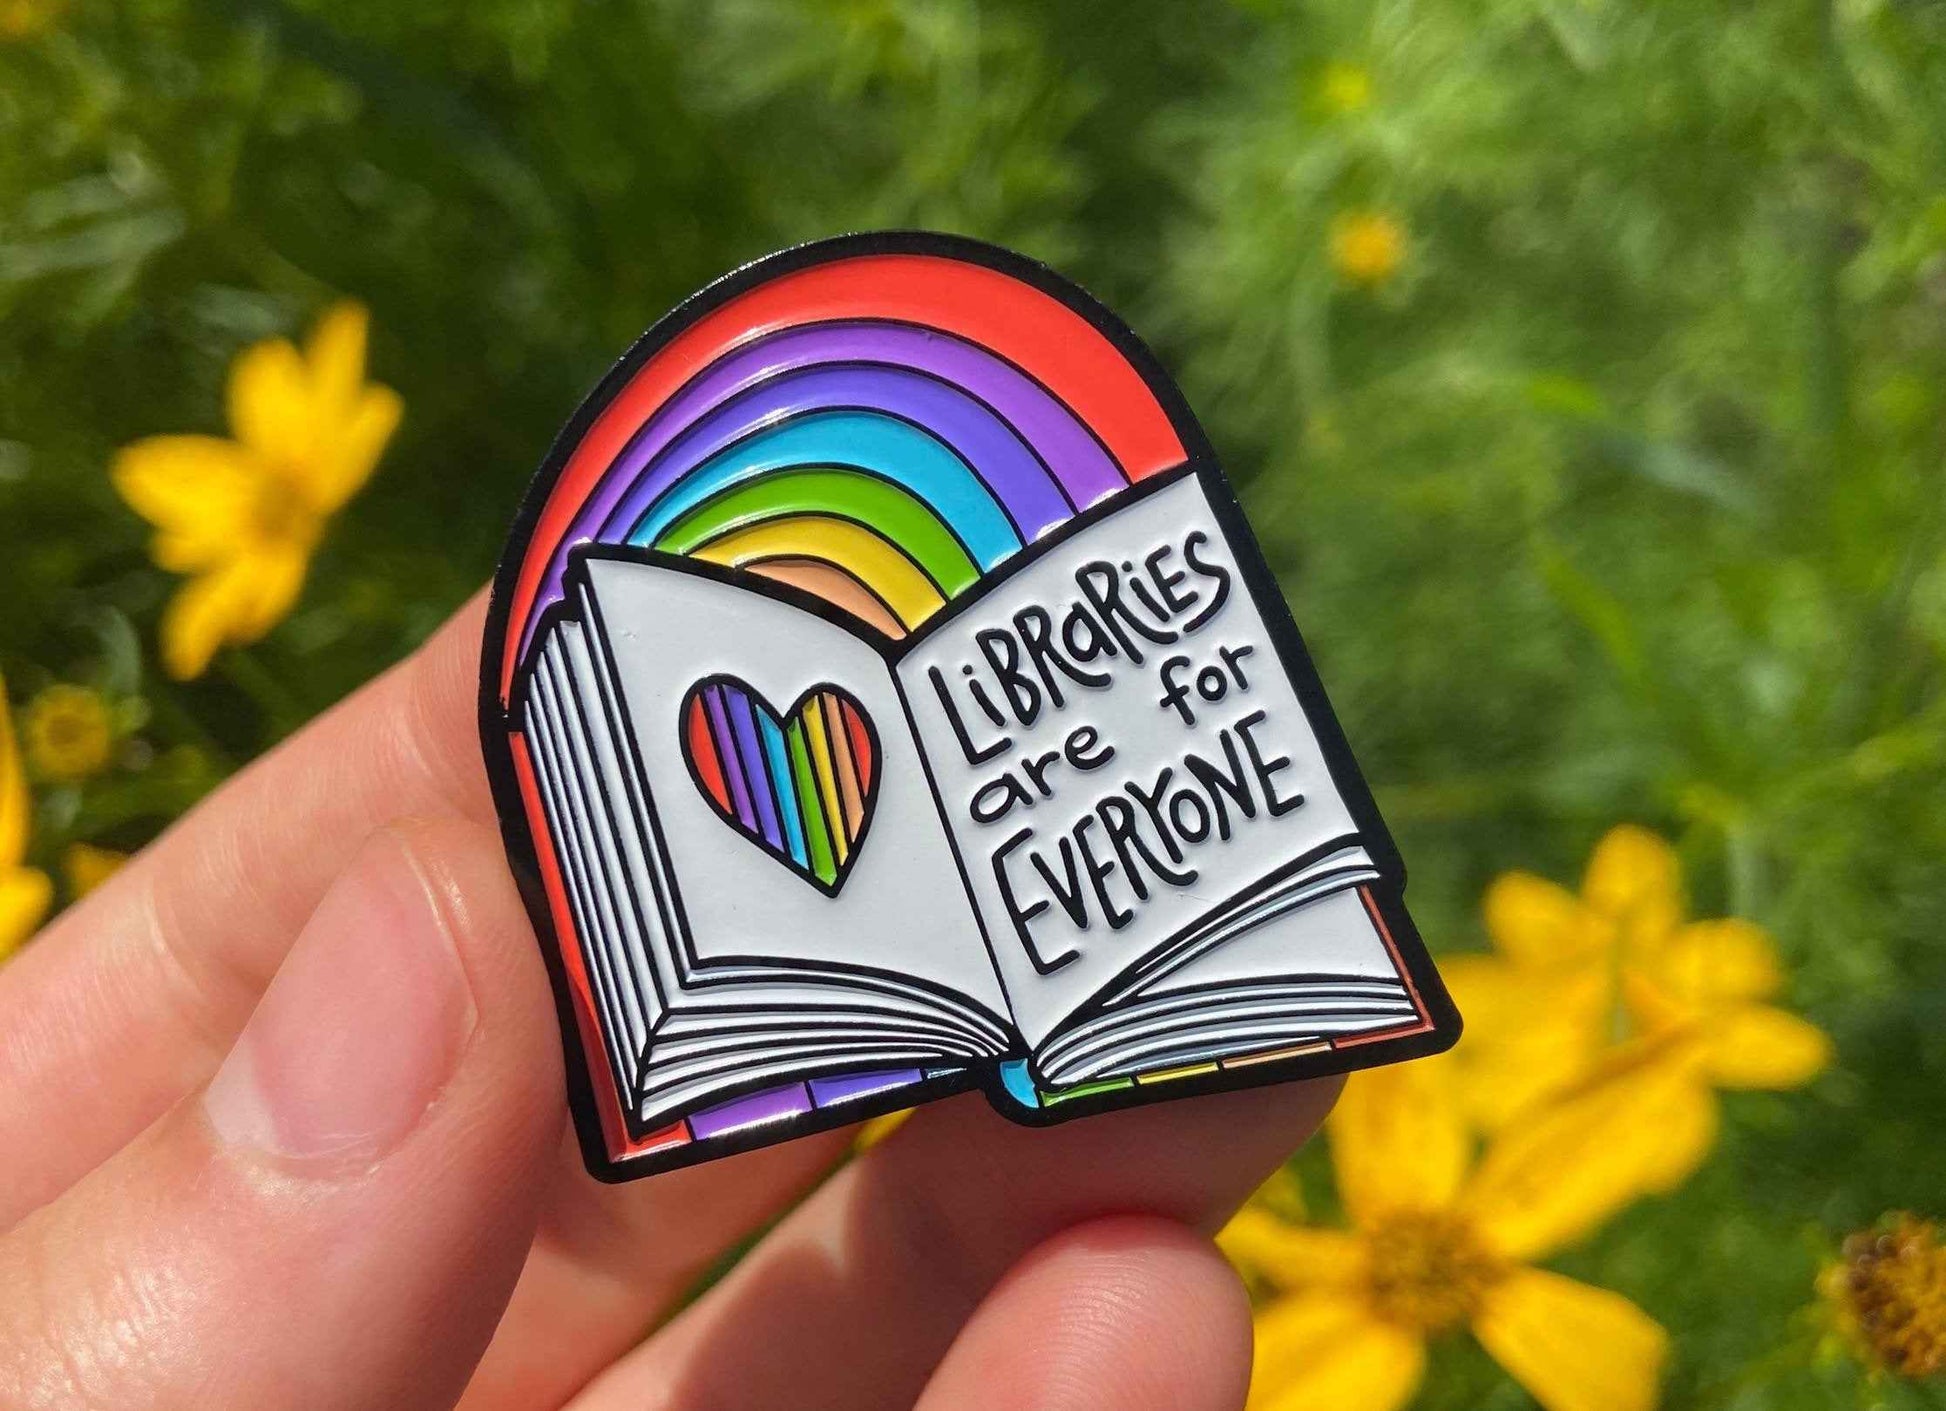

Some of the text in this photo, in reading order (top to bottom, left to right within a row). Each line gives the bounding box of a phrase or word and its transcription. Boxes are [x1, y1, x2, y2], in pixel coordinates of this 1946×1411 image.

[970, 645, 1253, 824] are for
[991, 710, 1305, 976] EVERYONE
